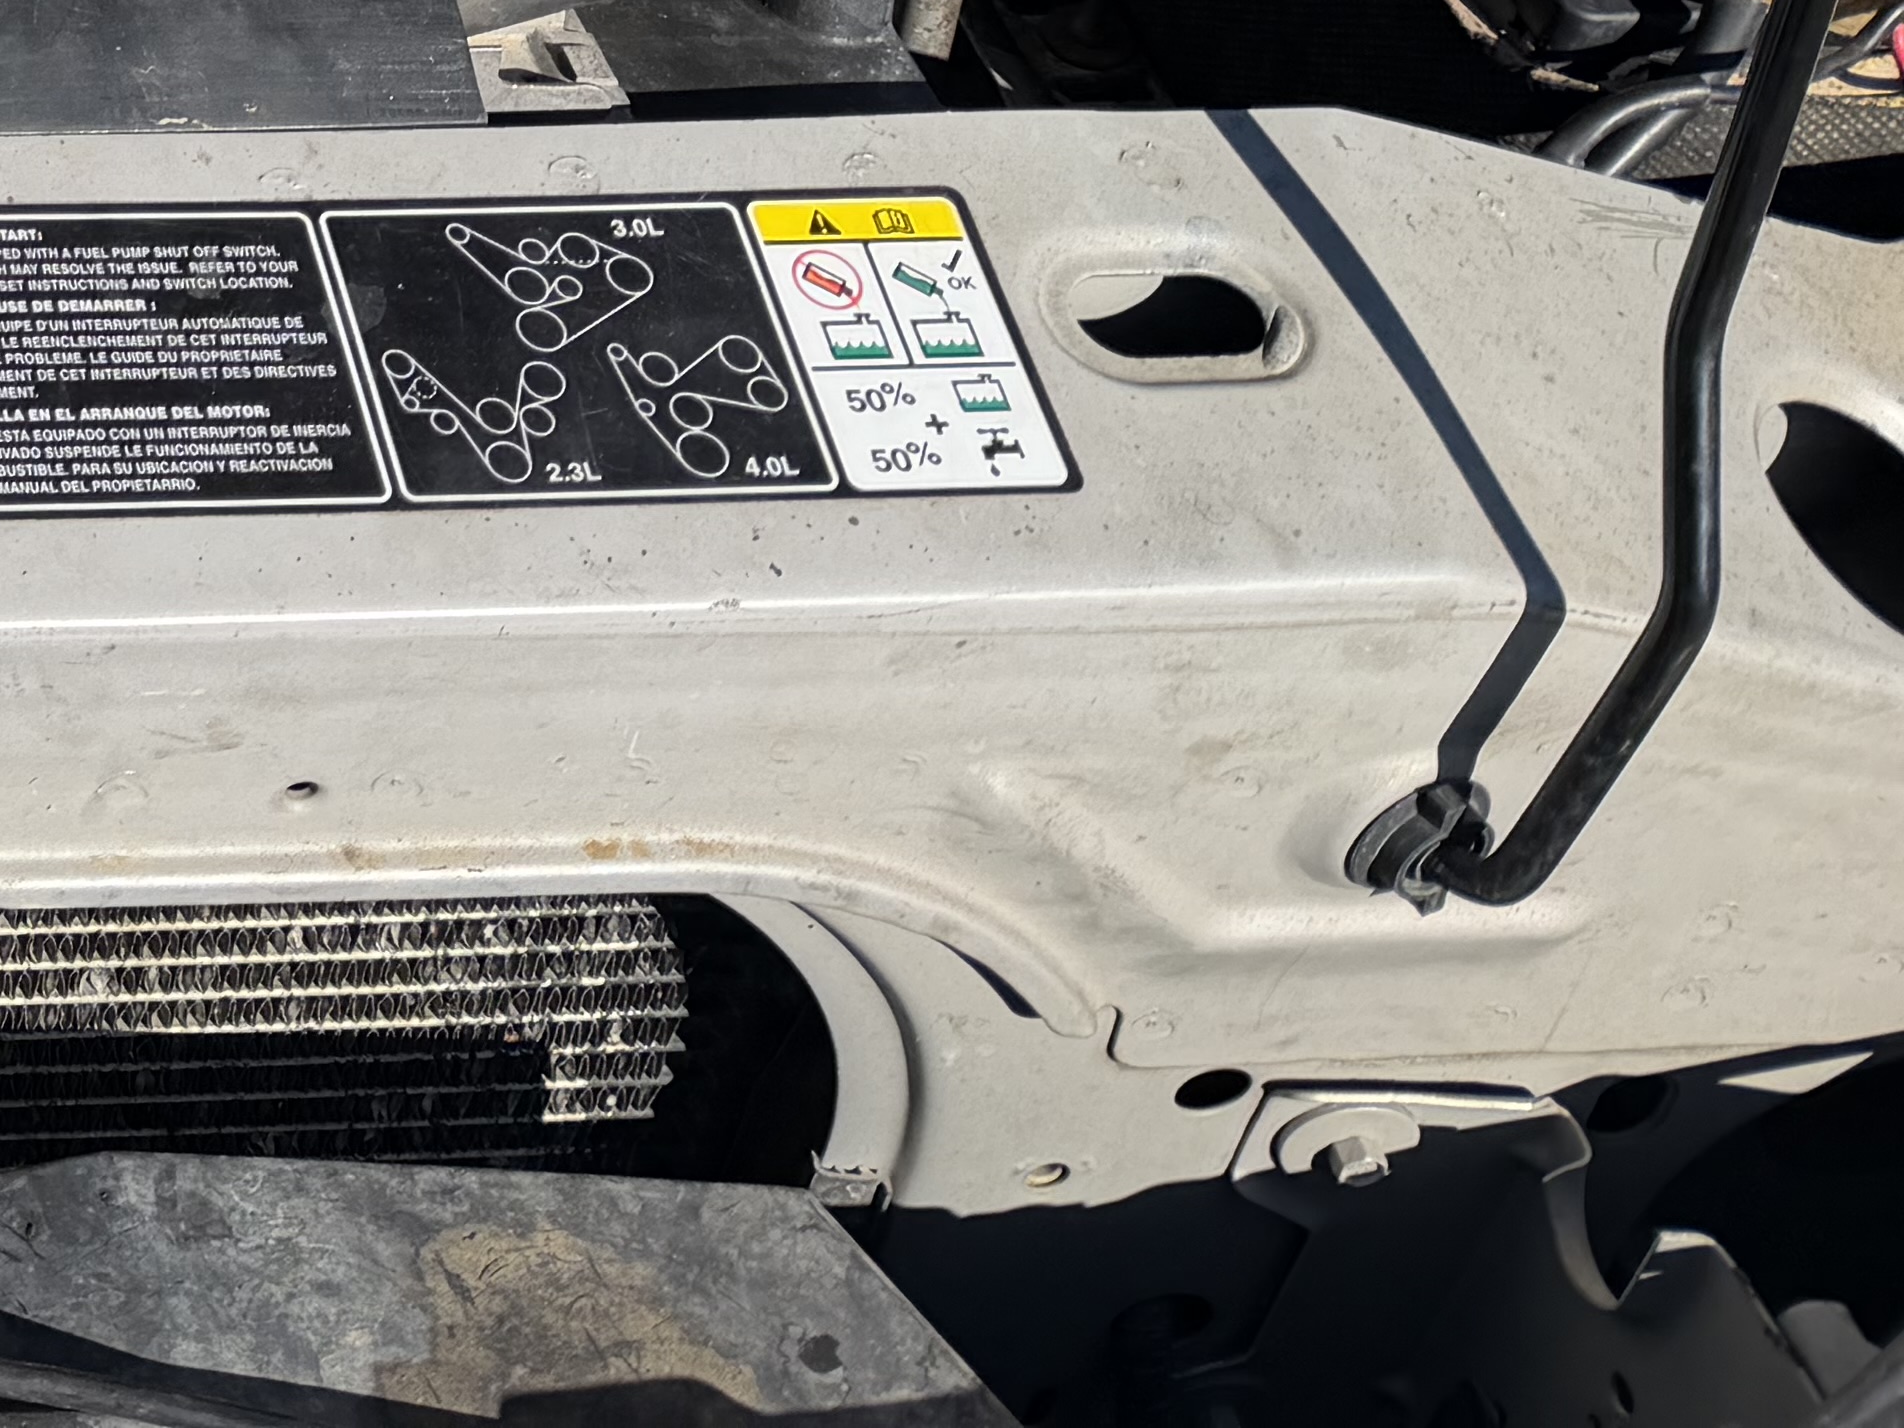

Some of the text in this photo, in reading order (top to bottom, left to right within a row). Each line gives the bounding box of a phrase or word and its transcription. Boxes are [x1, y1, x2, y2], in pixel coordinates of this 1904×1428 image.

[611, 218, 665, 239] 3.0L
[23, 247, 59, 259] WITH
[62, 248, 72, 259] A
[73, 247, 109, 259] FUEL
[111, 246, 150, 258] PUMP
[153, 245, 189, 258] SHUT
[192, 245, 219, 258] OFF
[222, 245, 280, 258] SWITCH.
[948, 274, 977, 292] OK
[31, 300, 54, 313] DE
[57, 298, 147, 313] DEMARRER
[846, 382, 916, 413] 50%
[744, 456, 801, 478] 4.0L
[870, 442, 943, 473] 50%
[546, 463, 602, 483] 2.3L
